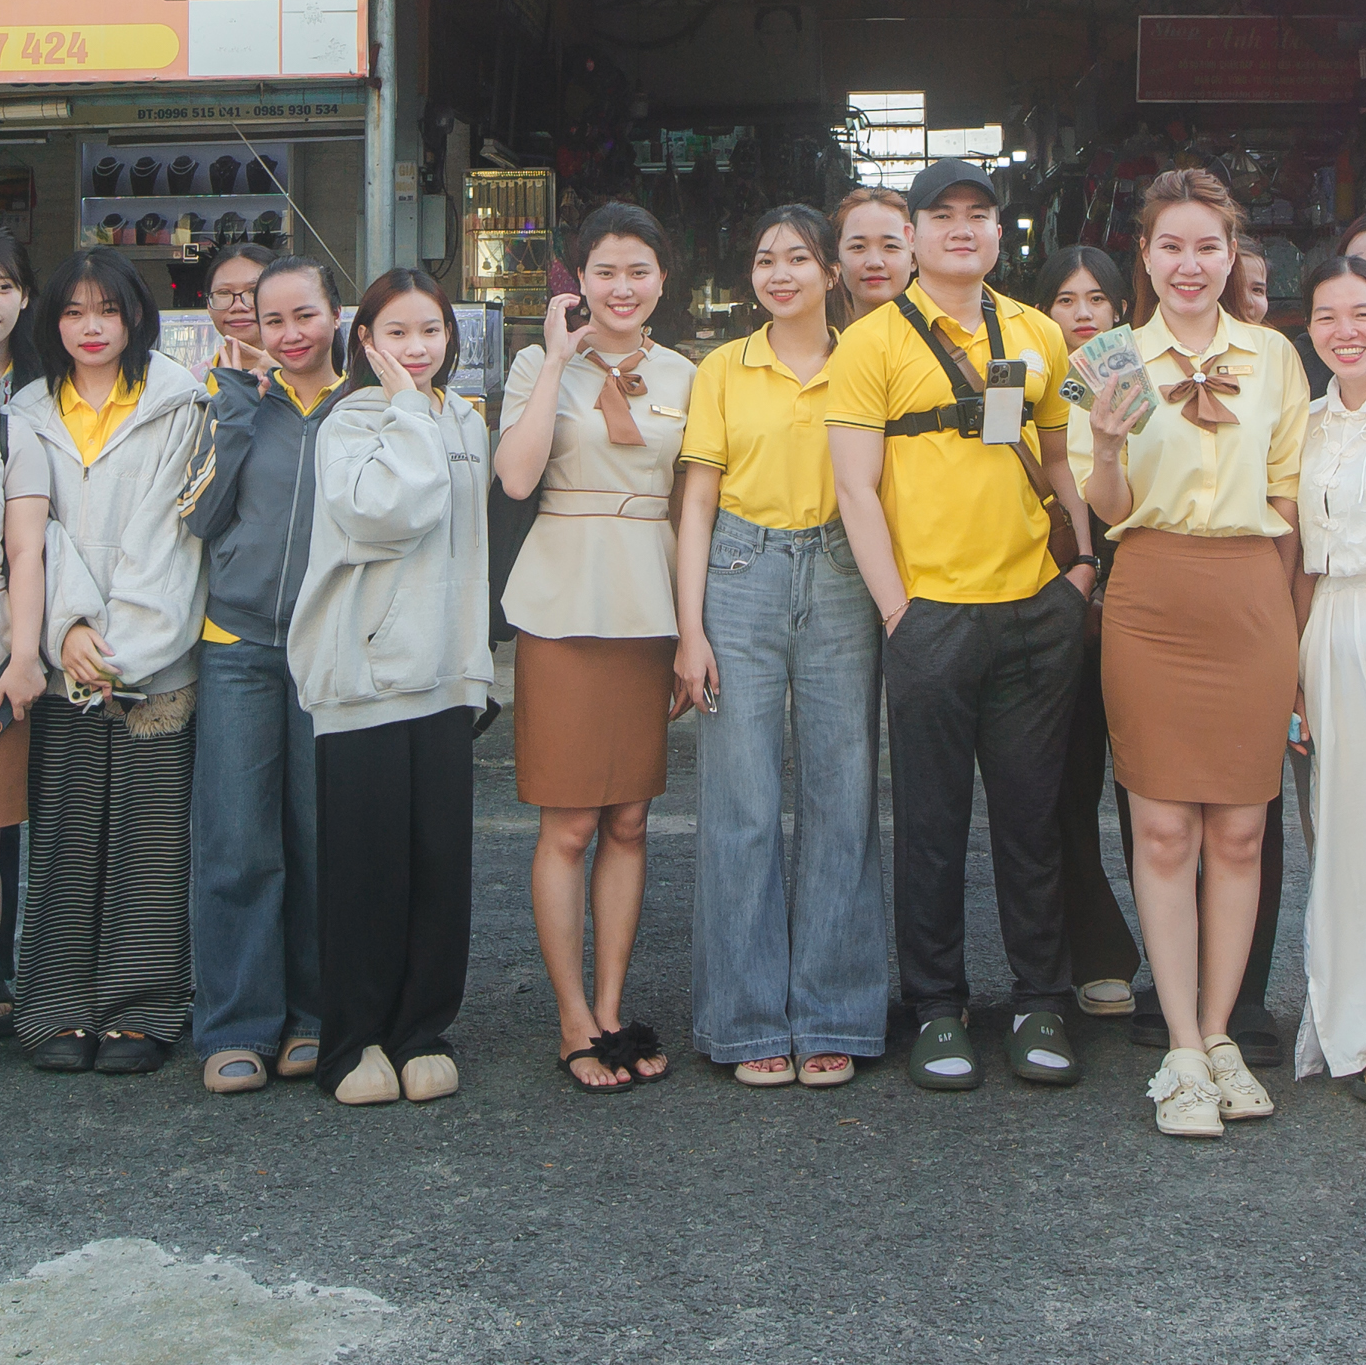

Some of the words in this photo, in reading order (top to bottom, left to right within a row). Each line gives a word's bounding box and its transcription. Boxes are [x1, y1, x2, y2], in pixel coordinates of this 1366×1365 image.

[21, 31, 89, 66] 424
[192, 107, 215, 120] 515
[253, 105, 285, 118] 0985
[288, 104, 311, 117] 930
[314, 103, 339, 116] 534
